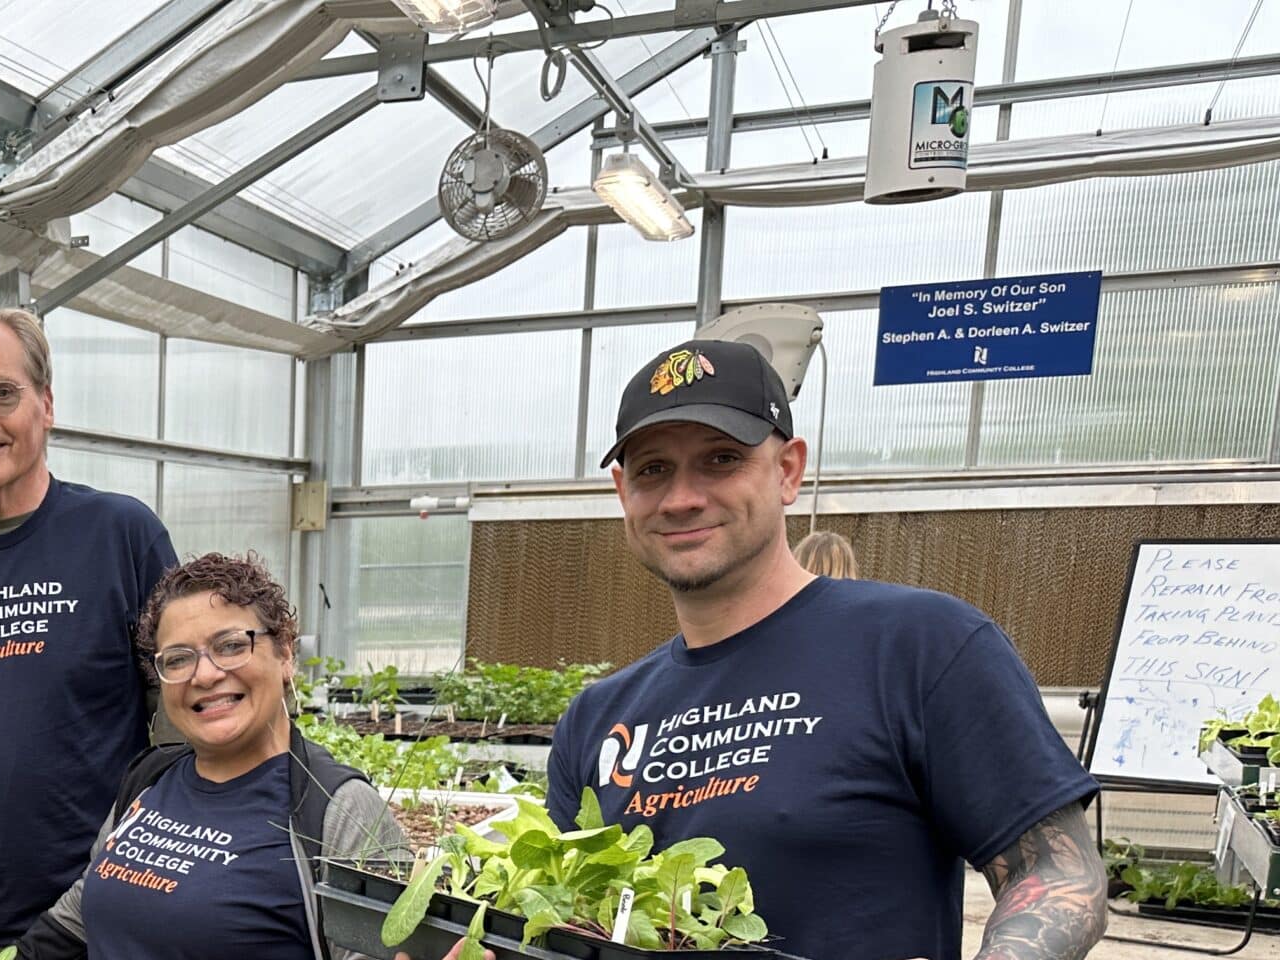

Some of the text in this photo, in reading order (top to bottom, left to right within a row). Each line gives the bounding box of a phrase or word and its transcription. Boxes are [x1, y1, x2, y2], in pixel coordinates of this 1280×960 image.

[934, 288, 987, 302] Memory
[991, 285, 1007, 297] Of
[1009, 284, 1036, 296] Our
[1039, 282, 1066, 294] Son
[928, 303, 960, 318] Joel
[963, 303, 978, 316] S.
[882, 320, 1090, 344] Stephen A. & Dorleen A. Switzer
[926, 365, 1035, 377] HIGHLAND COMMUNITY COLLEGE
[1145, 548, 1241, 574] PLEASE
[1140, 575, 1280, 604] REFRAIN FRO
[1134, 604, 1210, 624] TAKING
[1129, 629, 1278, 654] FROM BEHIND
[1123, 656, 1179, 677] THIS
[656, 692, 801, 737] HIGHLAND
[649, 716, 823, 757] COMMUNITY
[642, 745, 772, 783] COLLEGE
[624, 774, 761, 817] Agriculture
[141, 810, 233, 846] HIGHLAND
[115, 841, 195, 875] COLLEGE
[128, 826, 240, 866] COMMUNITY
[95, 857, 179, 893] Agriculture
